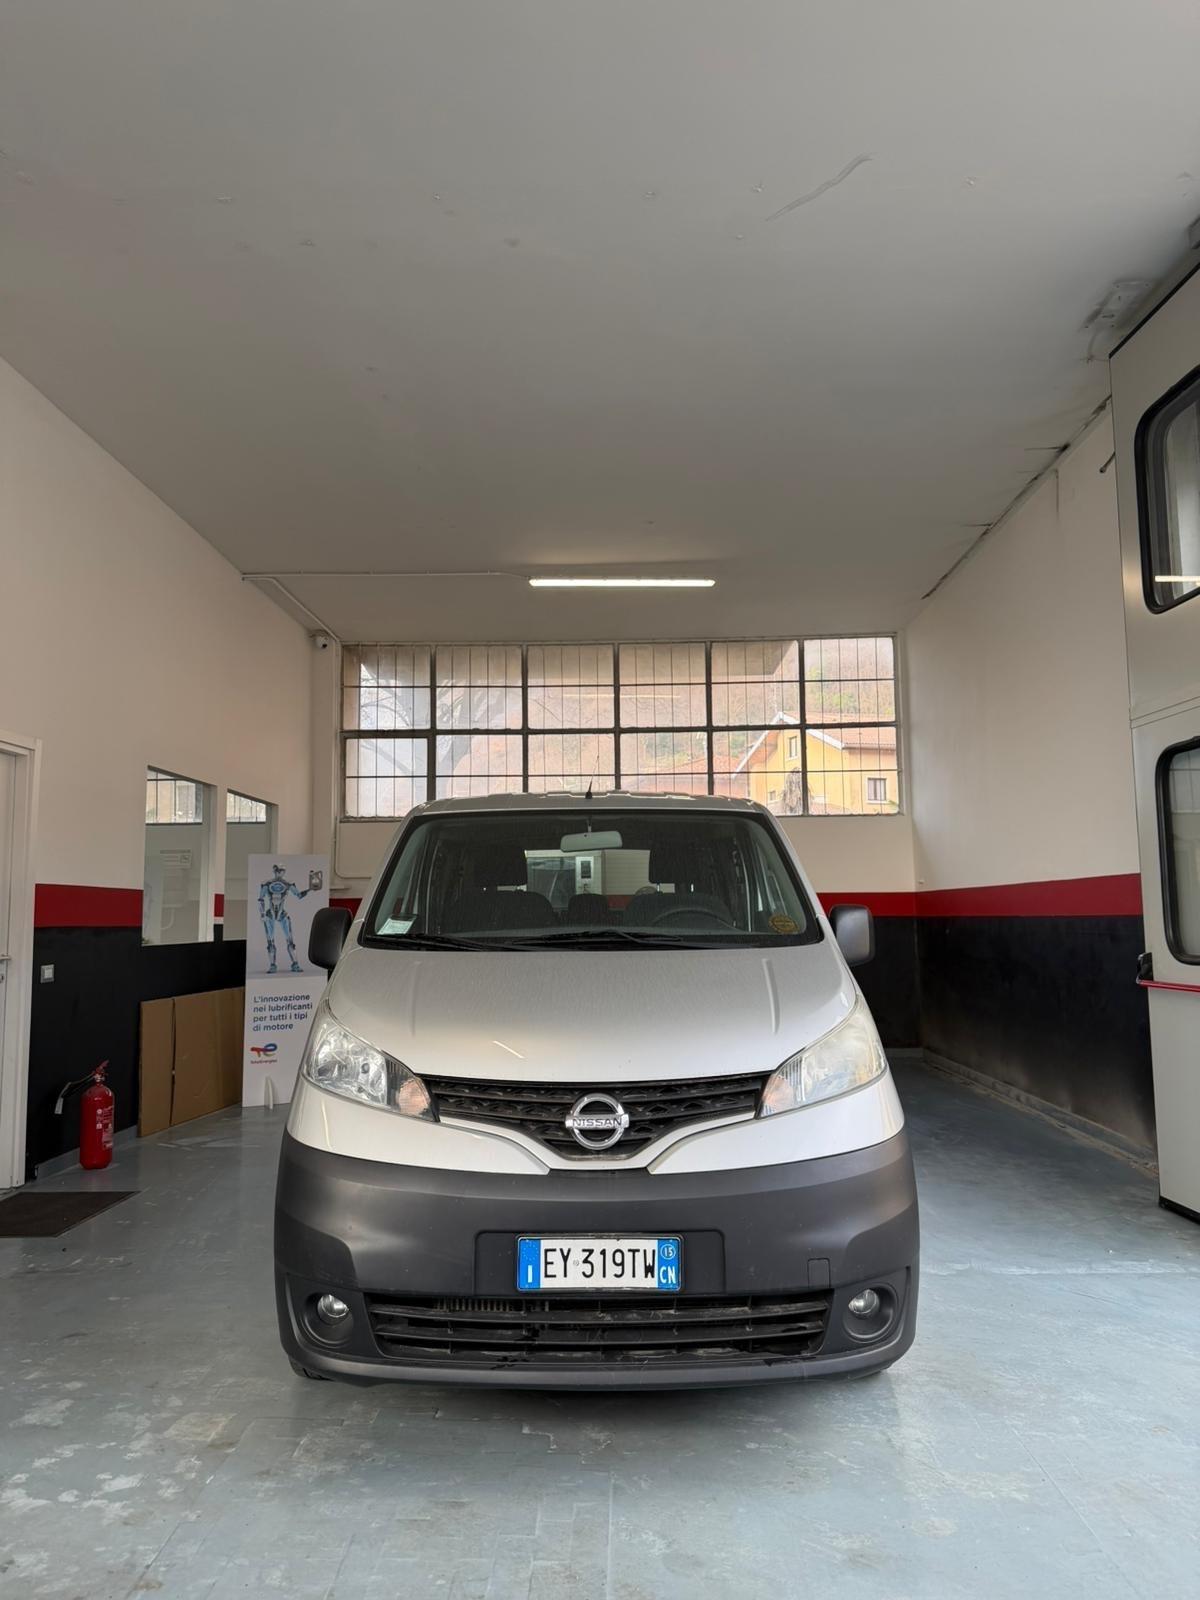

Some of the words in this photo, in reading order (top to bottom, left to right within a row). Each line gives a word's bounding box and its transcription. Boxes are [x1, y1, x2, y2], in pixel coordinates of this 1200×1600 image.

[253, 994, 310, 1003] L'innovazione
[268, 1002, 313, 1011] lubrificanti
[253, 1015, 267, 1023] per
[269, 1013, 287, 1021] tutti
[294, 1011, 308, 1020] tipi
[263, 1023, 294, 1031] motore
[572, 1117, 622, 1128] NISSAN
[659, 1266, 677, 1284] CN
